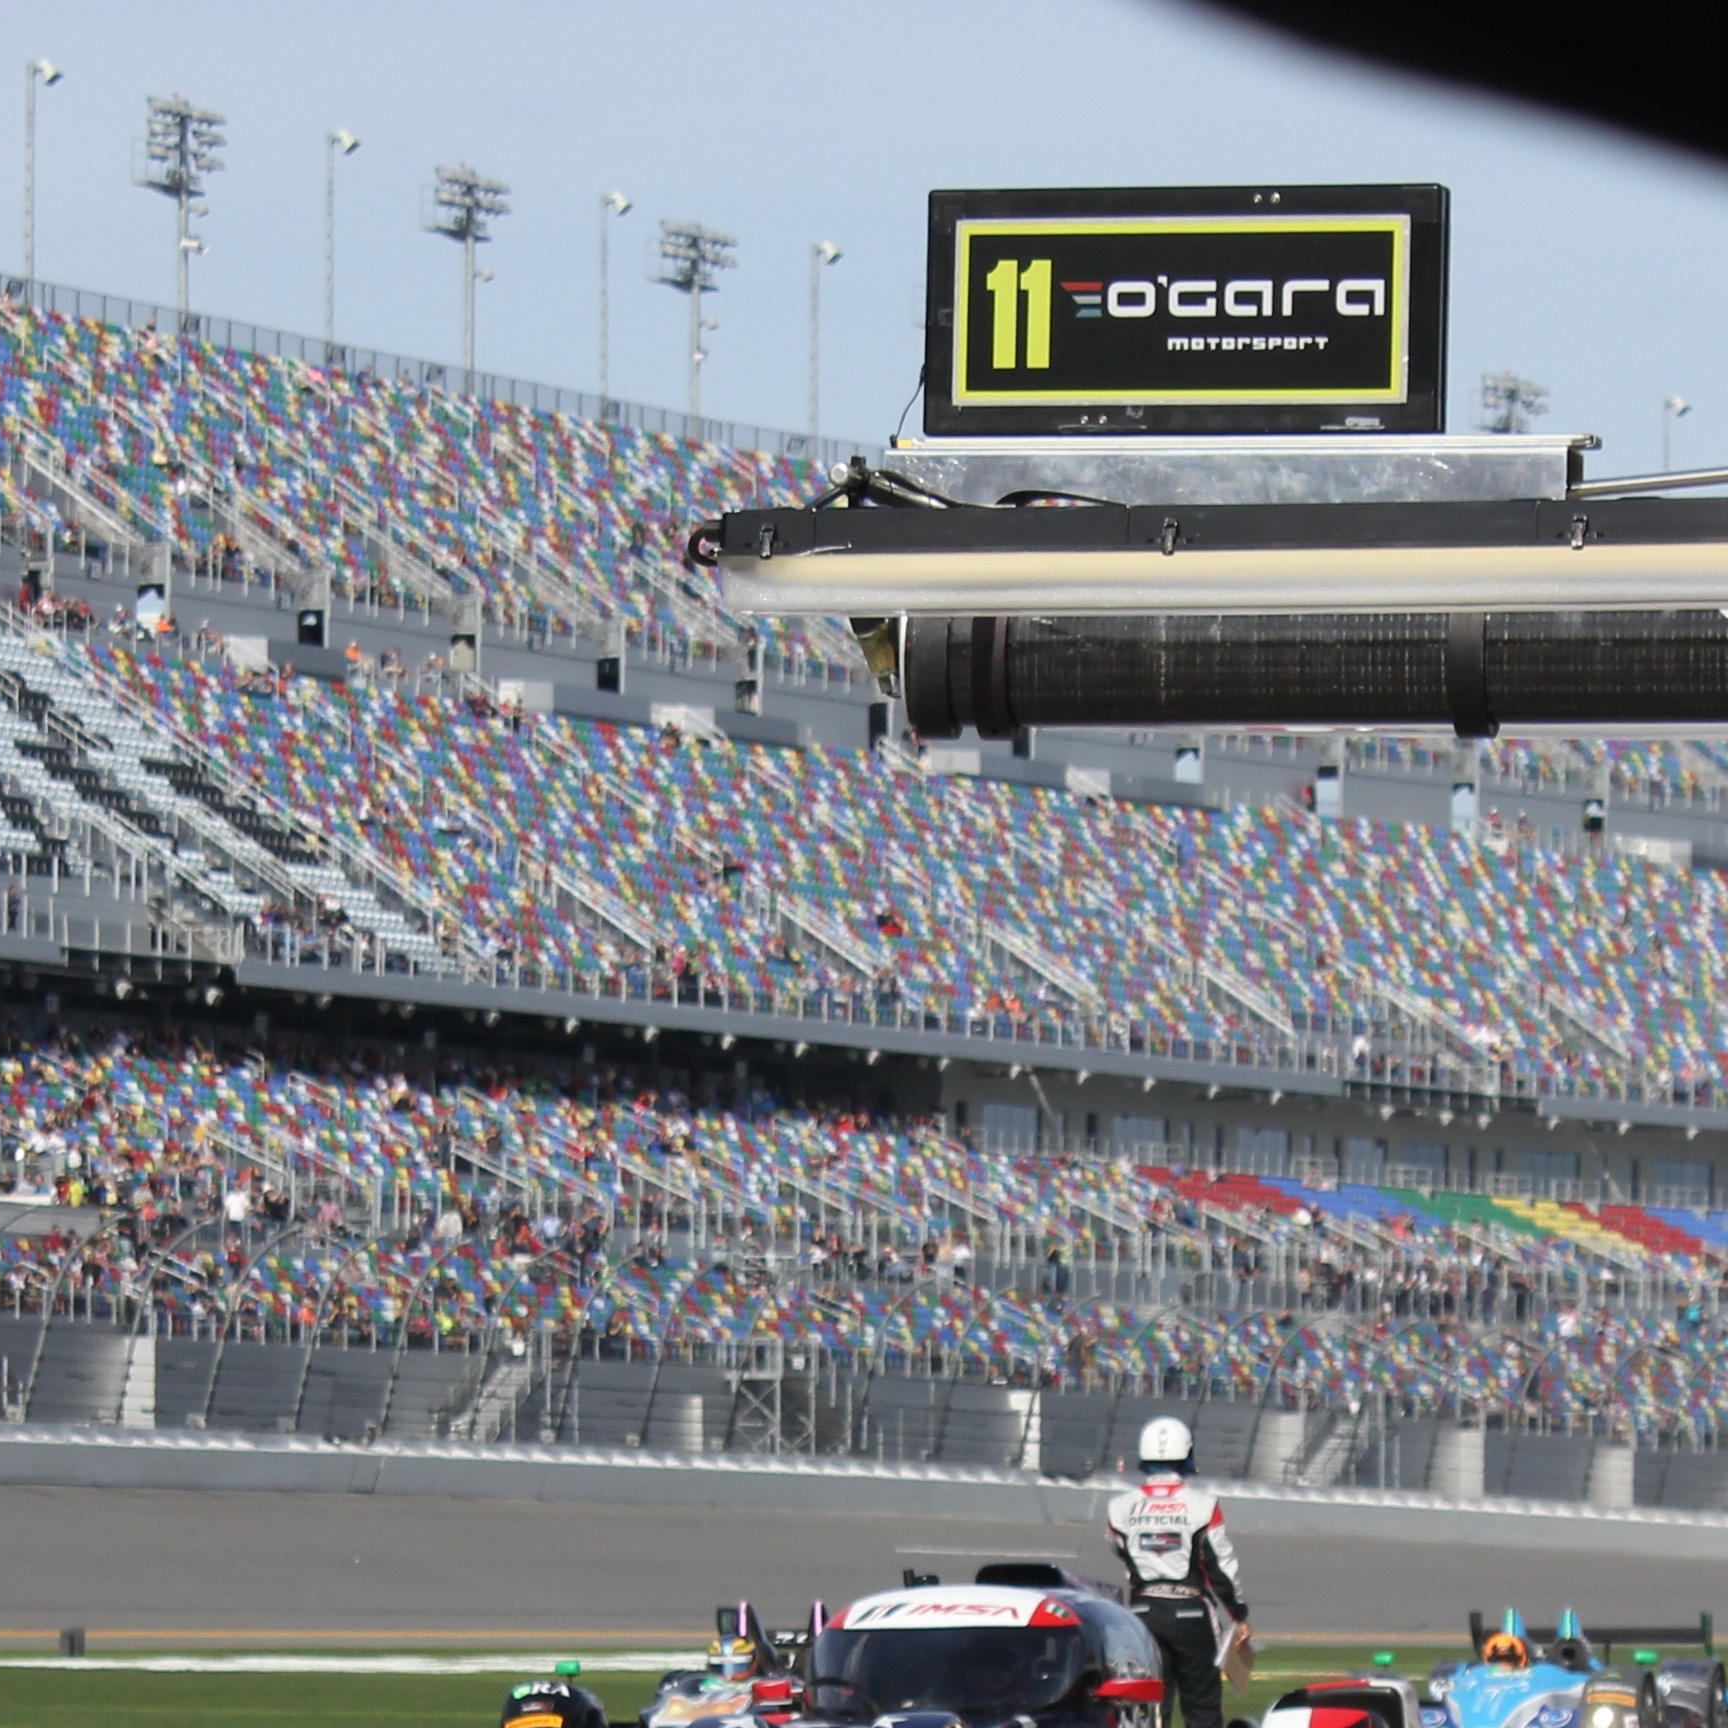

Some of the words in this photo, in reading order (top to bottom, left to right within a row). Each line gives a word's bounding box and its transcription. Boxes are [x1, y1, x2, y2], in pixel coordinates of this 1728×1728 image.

[986, 258, 1052, 370] 11
[1147, 1503, 1189, 1514] IMSA
[1129, 1515, 1191, 1526] OFFICIAL
[905, 1602, 1021, 1620] IMSA
